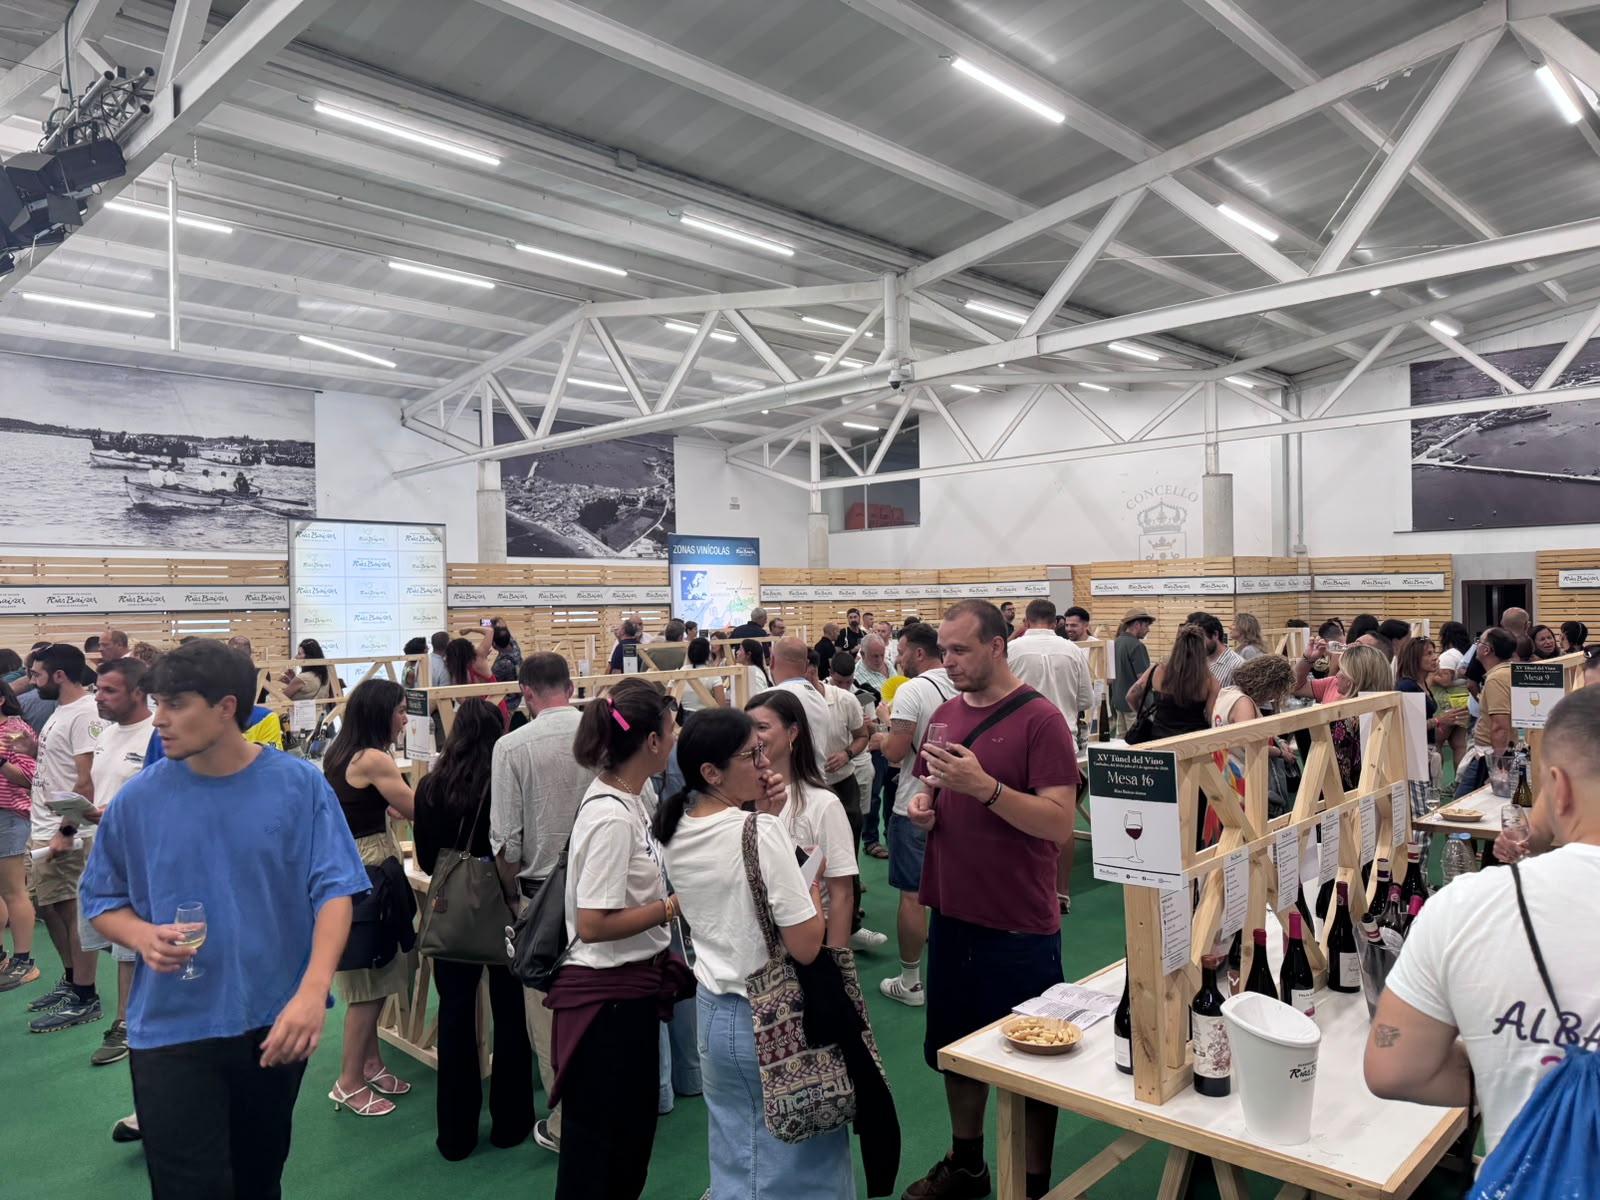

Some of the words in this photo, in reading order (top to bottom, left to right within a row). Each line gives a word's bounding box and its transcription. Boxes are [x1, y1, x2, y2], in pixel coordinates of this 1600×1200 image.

[1126, 484, 1198, 510] CONCELLO
[672, 544, 696, 554] ZONAS
[696, 544, 730, 555] VINÍCOLAS
[1110, 754, 1130, 763] Túnel
[1144, 756, 1164, 765] Vino
[1107, 770, 1138, 786] Mesa
[1142, 774, 1154, 786] 16
[1289, 1067, 1310, 1079] Rías
